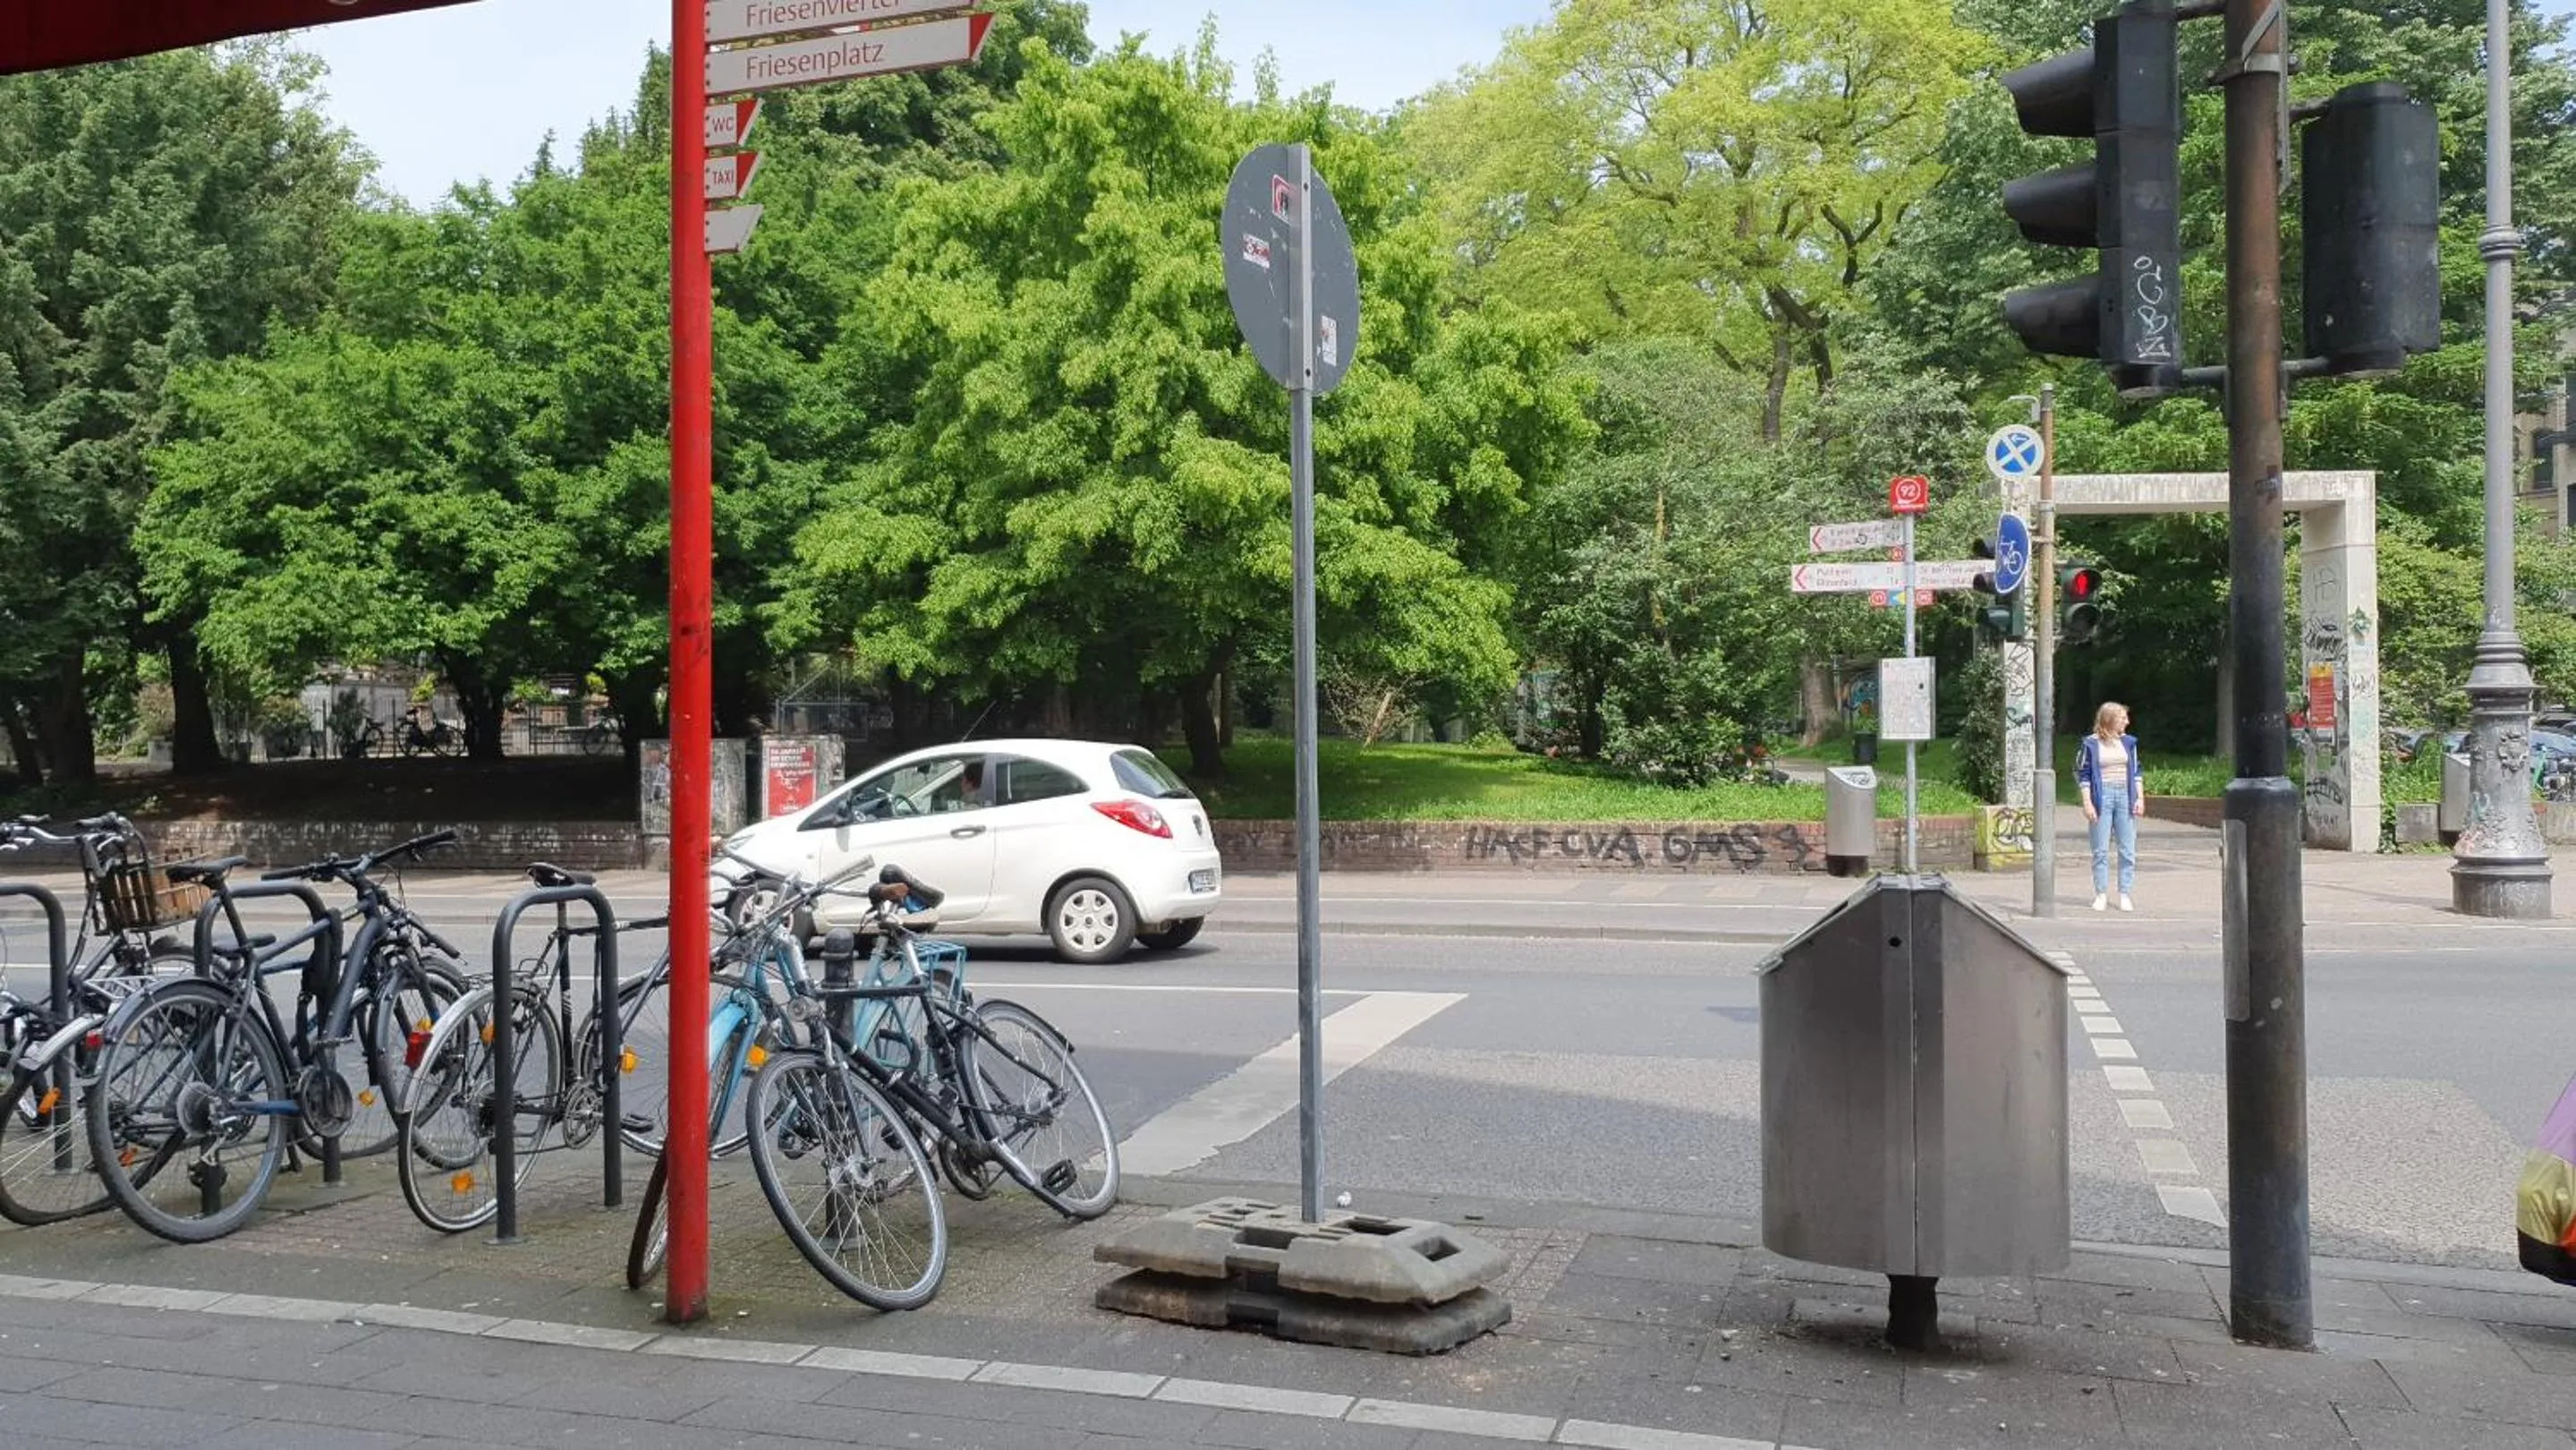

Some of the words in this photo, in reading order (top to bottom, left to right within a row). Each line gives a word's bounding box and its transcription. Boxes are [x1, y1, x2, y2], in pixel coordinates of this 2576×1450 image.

[746, 0, 899, 28] Friesenvierte
[746, 41, 885, 81] Friesenplatz
[712, 116, 735, 132] WC
[712, 168, 735, 185] TAXI
[1900, 484, 1916, 498] 92
